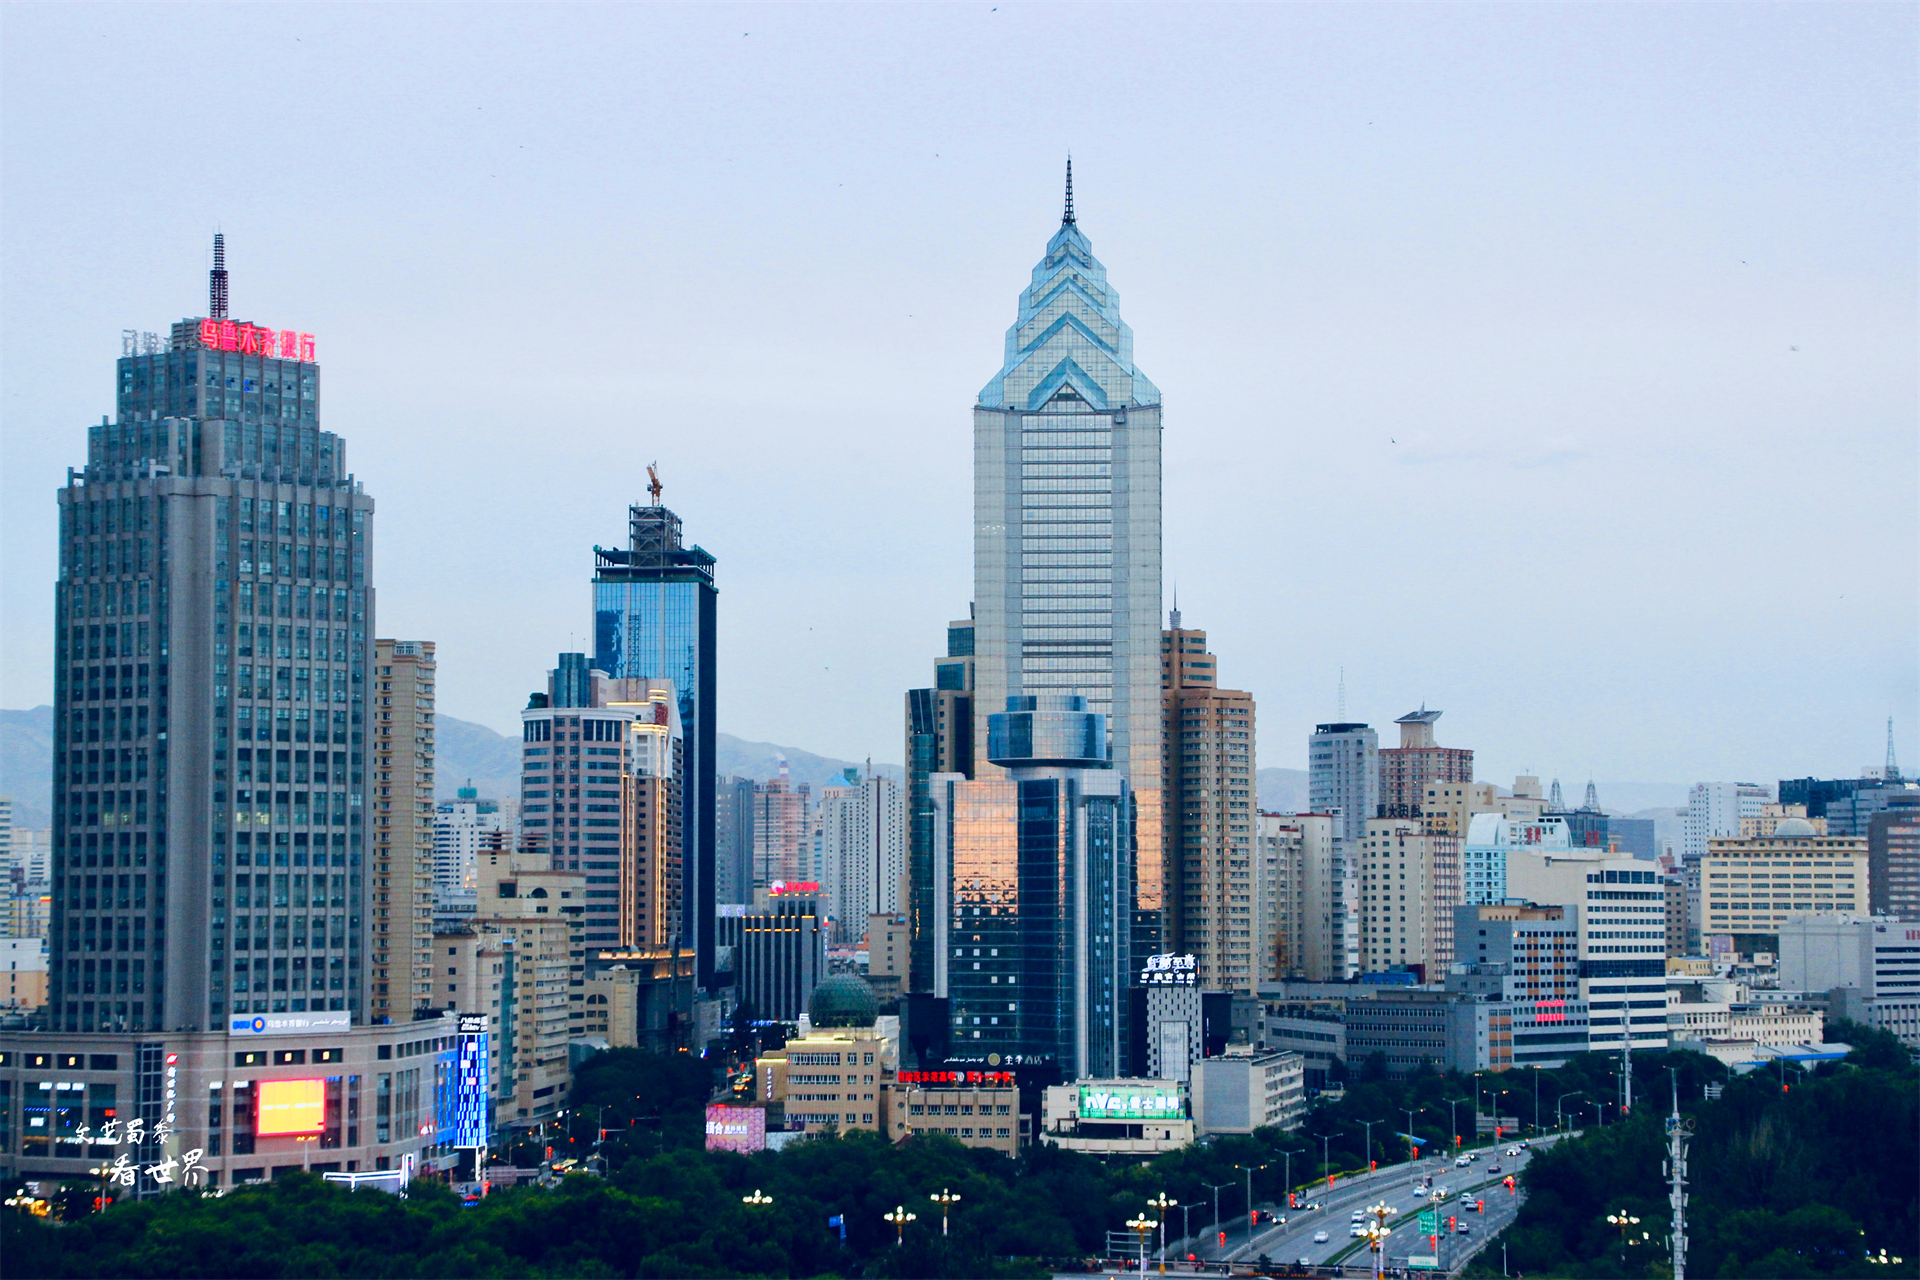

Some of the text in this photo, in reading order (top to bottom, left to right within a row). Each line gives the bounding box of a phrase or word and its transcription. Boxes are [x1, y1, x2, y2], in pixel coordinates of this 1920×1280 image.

[200, 318, 316, 362] 乌鲁木齐银行
